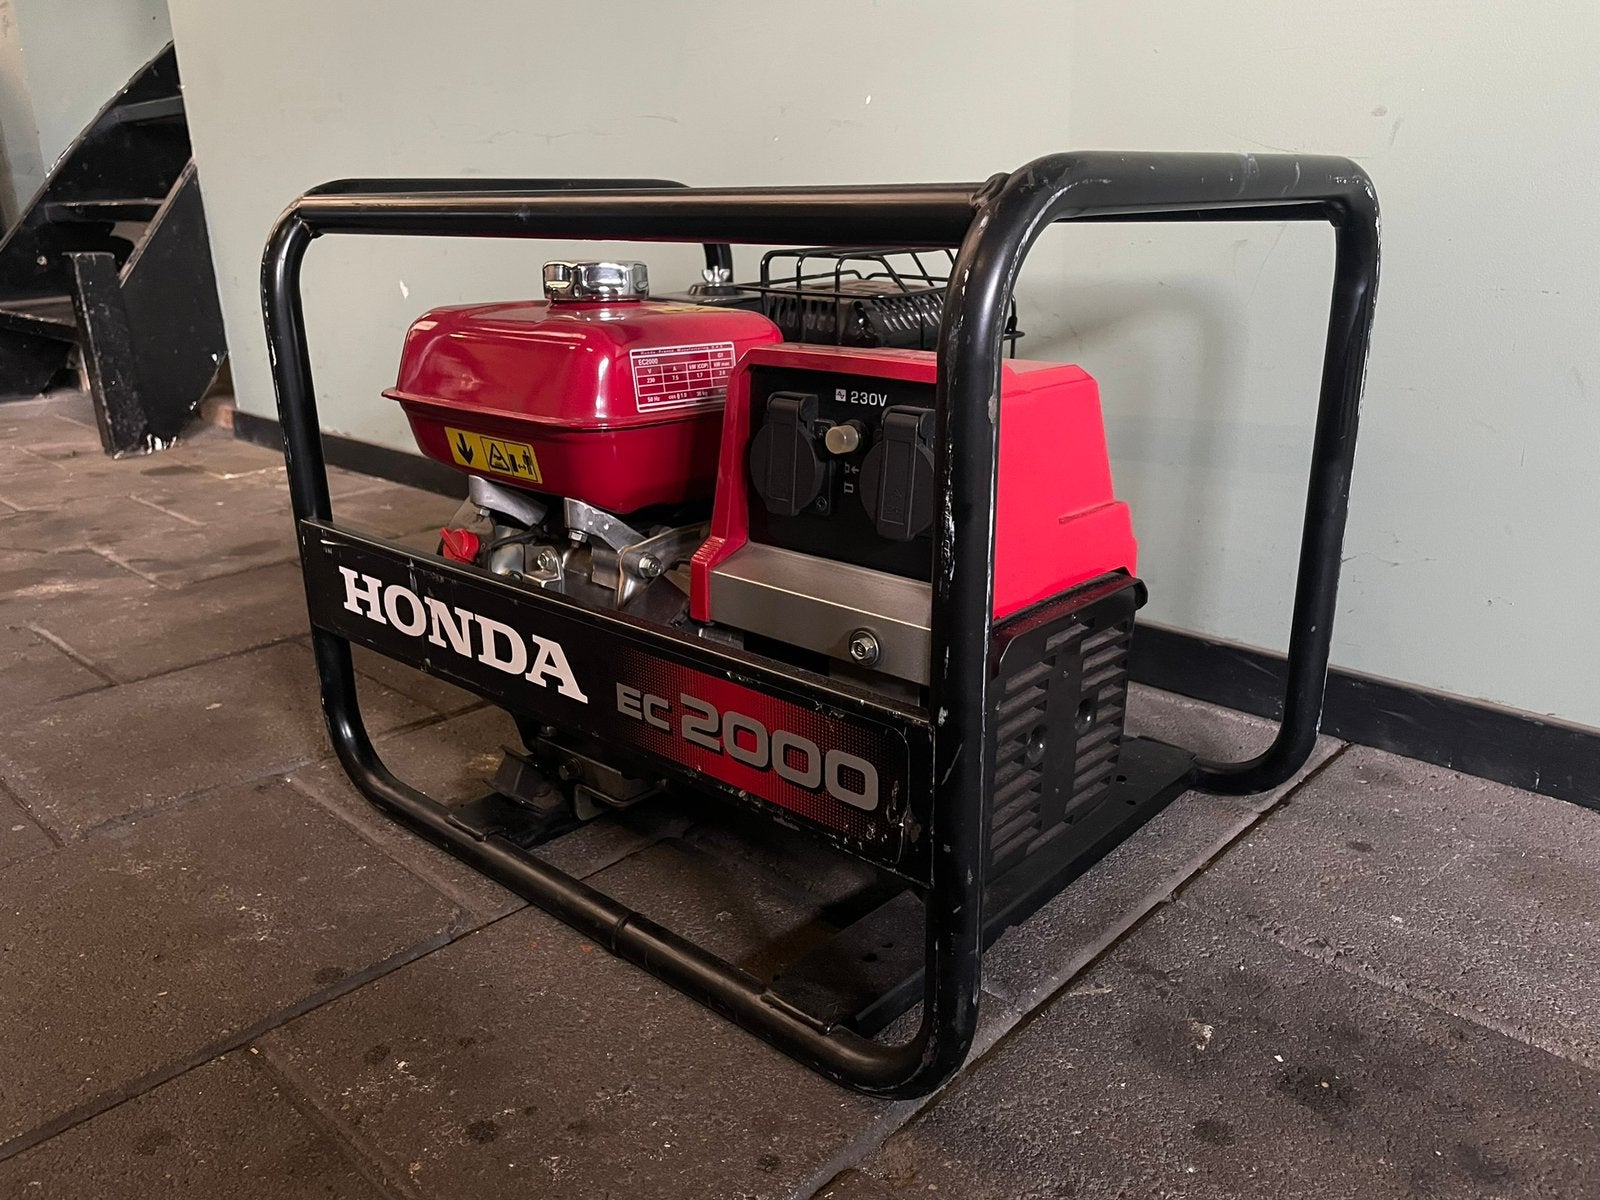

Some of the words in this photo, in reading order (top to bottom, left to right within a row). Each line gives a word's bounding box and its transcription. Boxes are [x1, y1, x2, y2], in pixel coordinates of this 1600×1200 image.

[850, 391, 888, 407] 230V
[339, 565, 588, 704] HONDA
[616, 682, 670, 731] EC
[680, 692, 878, 811] 2000
